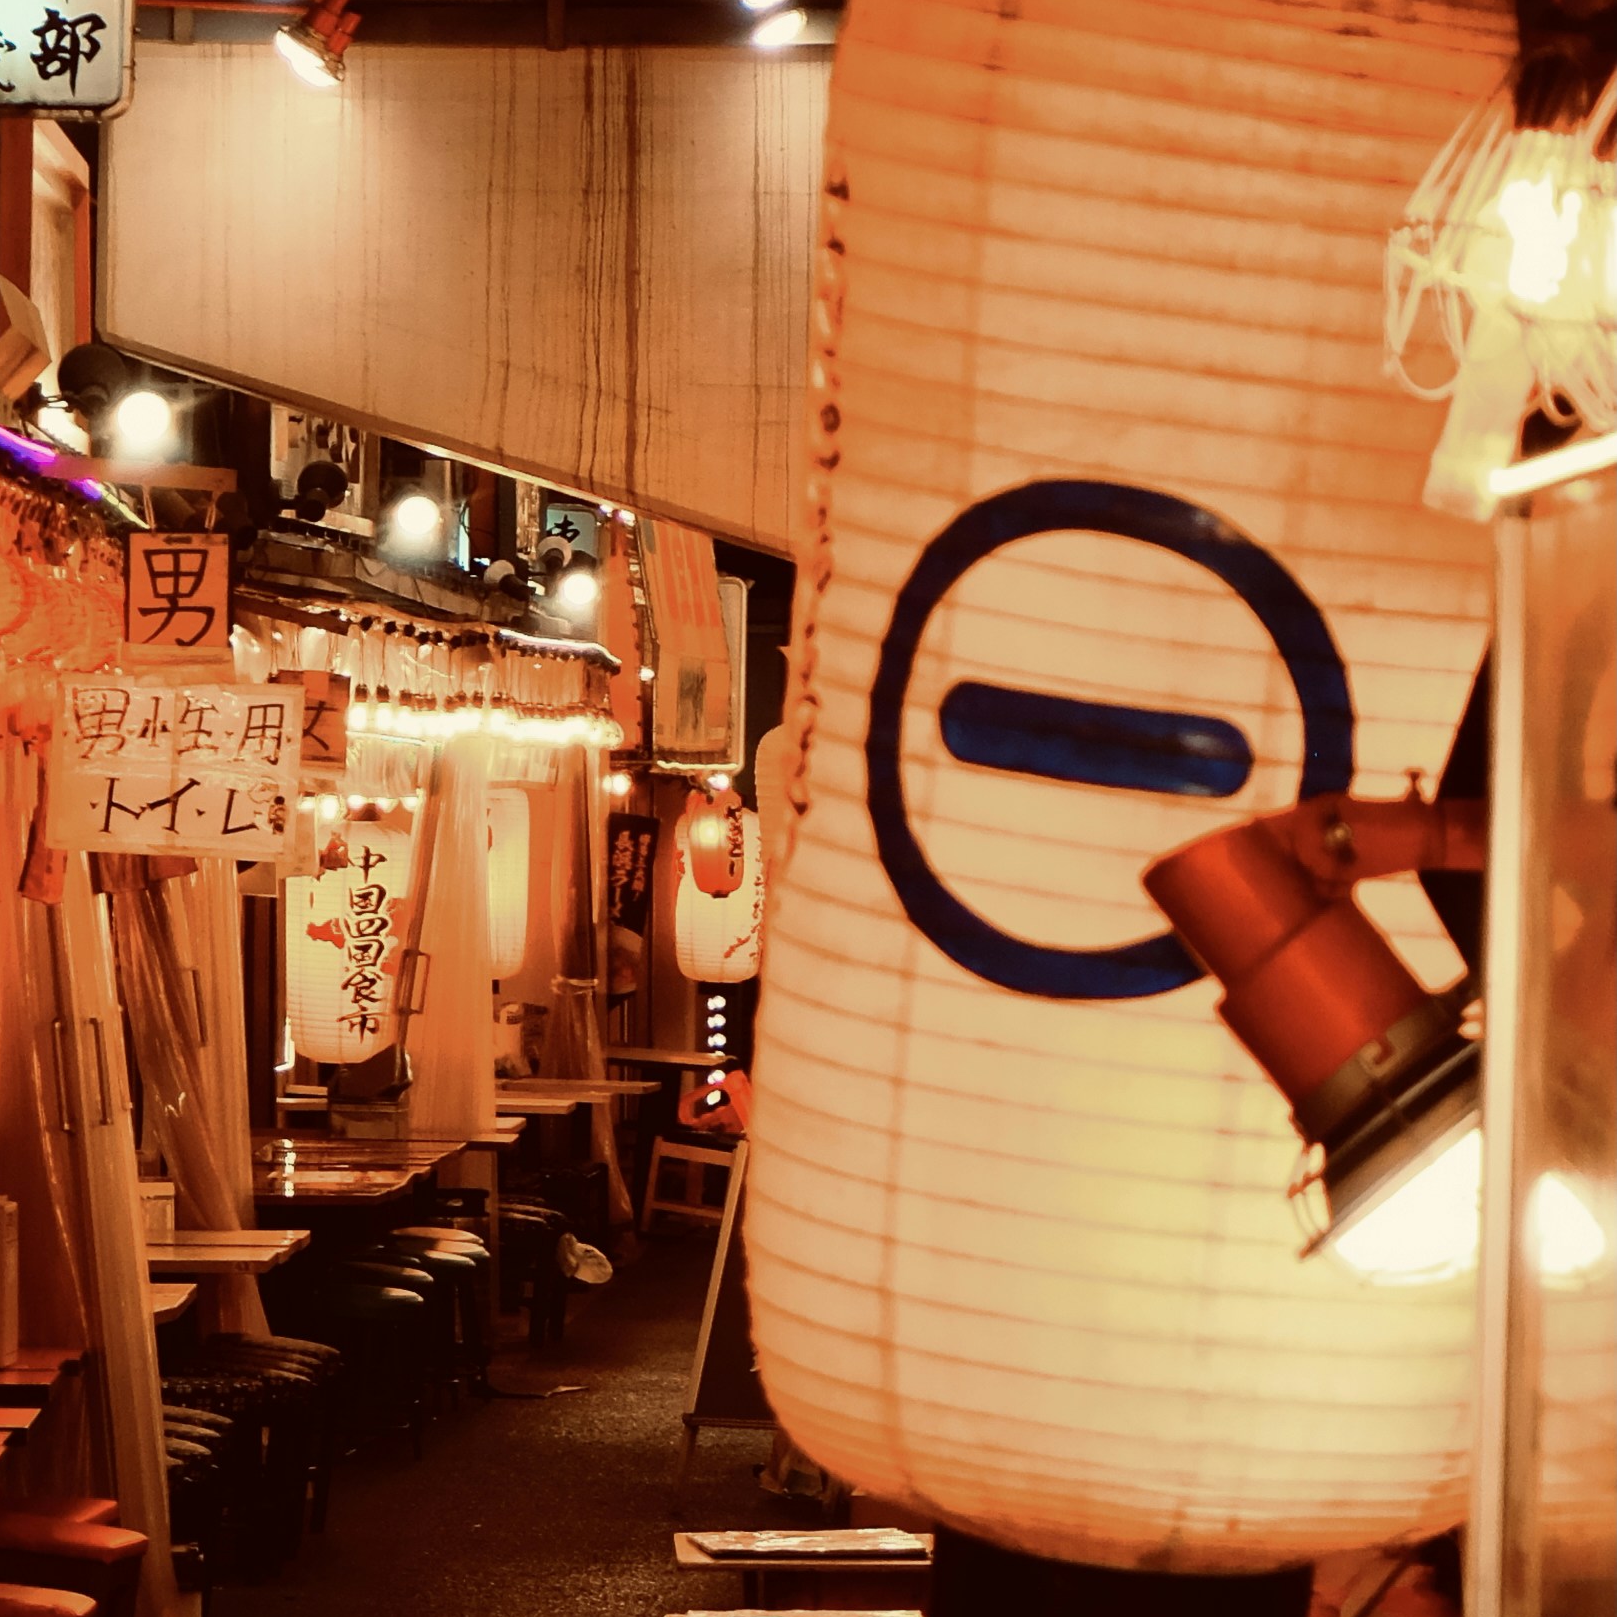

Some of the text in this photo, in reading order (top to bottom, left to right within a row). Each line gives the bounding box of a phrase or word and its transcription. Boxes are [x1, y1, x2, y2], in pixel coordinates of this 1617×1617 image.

[138, 548, 215, 646] 男
[72, 686, 285, 766] 男性用
[98, 777, 260, 835] トイレ
[336, 845, 390, 1044] 中国四国食市
